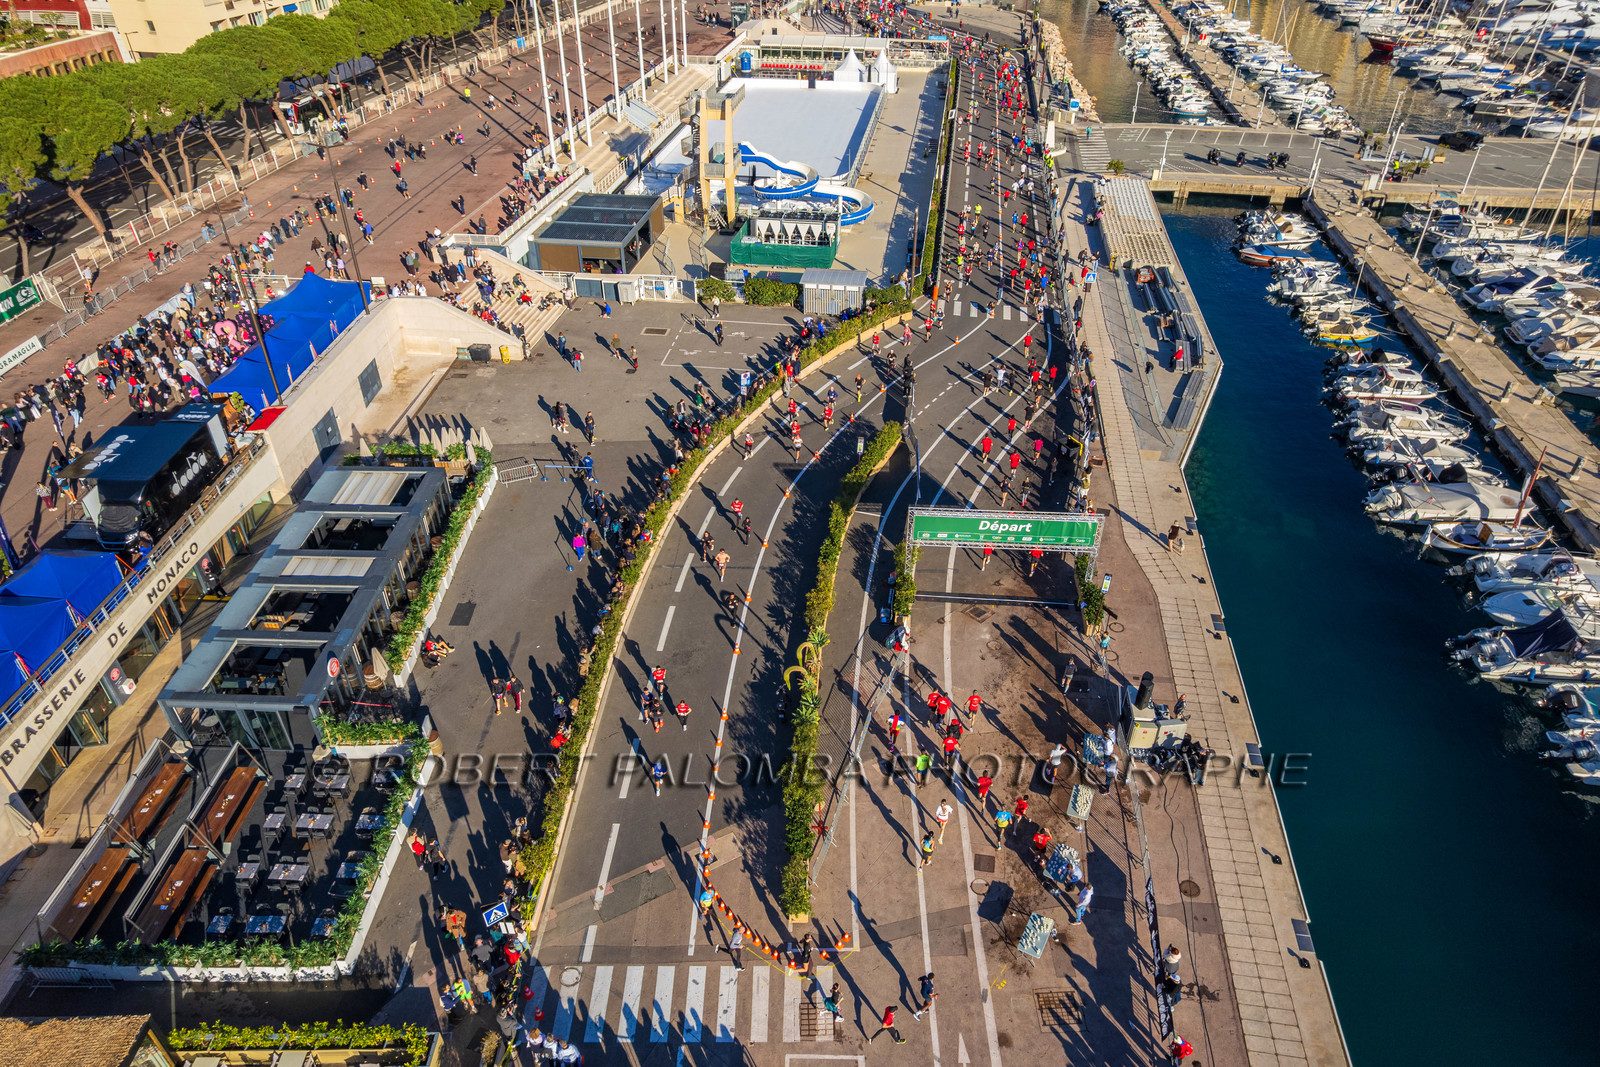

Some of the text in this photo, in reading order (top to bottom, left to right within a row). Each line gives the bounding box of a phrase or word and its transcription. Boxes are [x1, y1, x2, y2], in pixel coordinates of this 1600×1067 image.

[169, 452, 208, 495] diadora
[978, 520, 1033, 534] Départ
[0, 542, 199, 766] BRASSERIE DE MONACO
